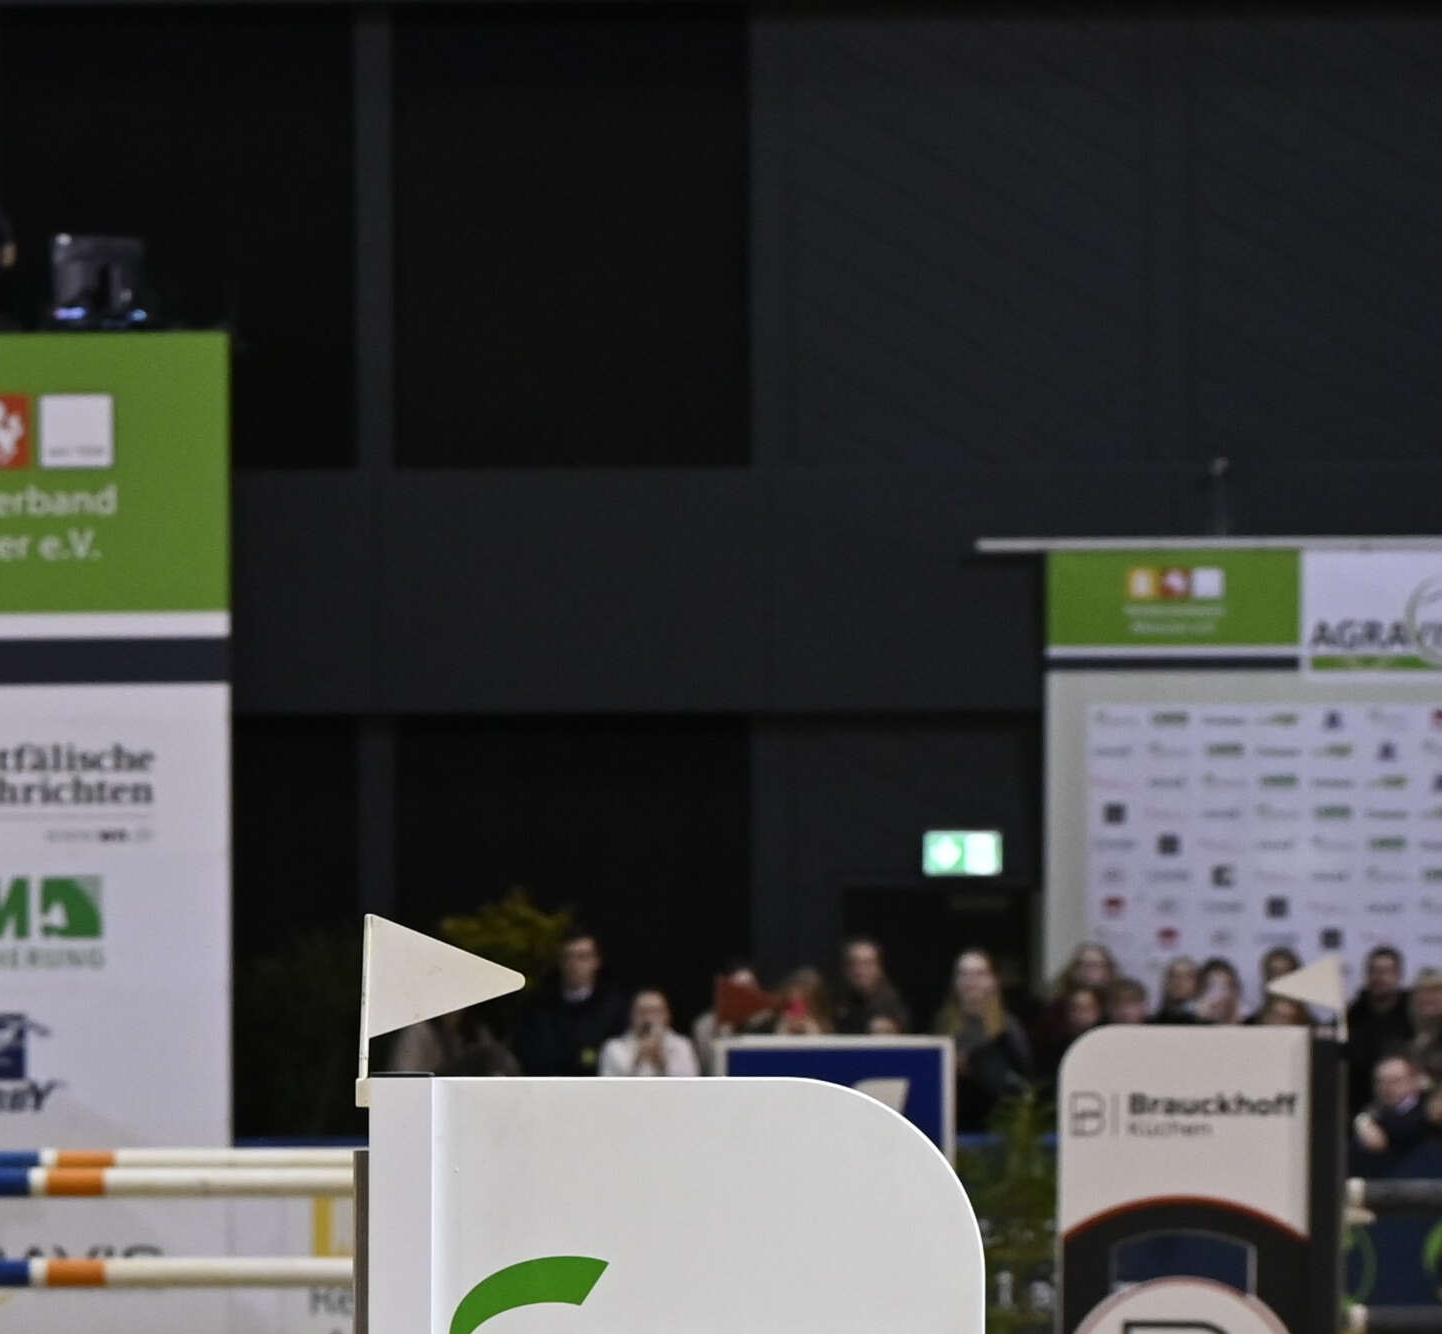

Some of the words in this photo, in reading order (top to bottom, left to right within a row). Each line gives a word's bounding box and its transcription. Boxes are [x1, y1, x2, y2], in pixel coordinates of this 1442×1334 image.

[38, 530, 100, 560] e.V.
[1126, 1091, 1298, 1117] Brauckhoff
[1126, 1117, 1213, 1138] Küchen
